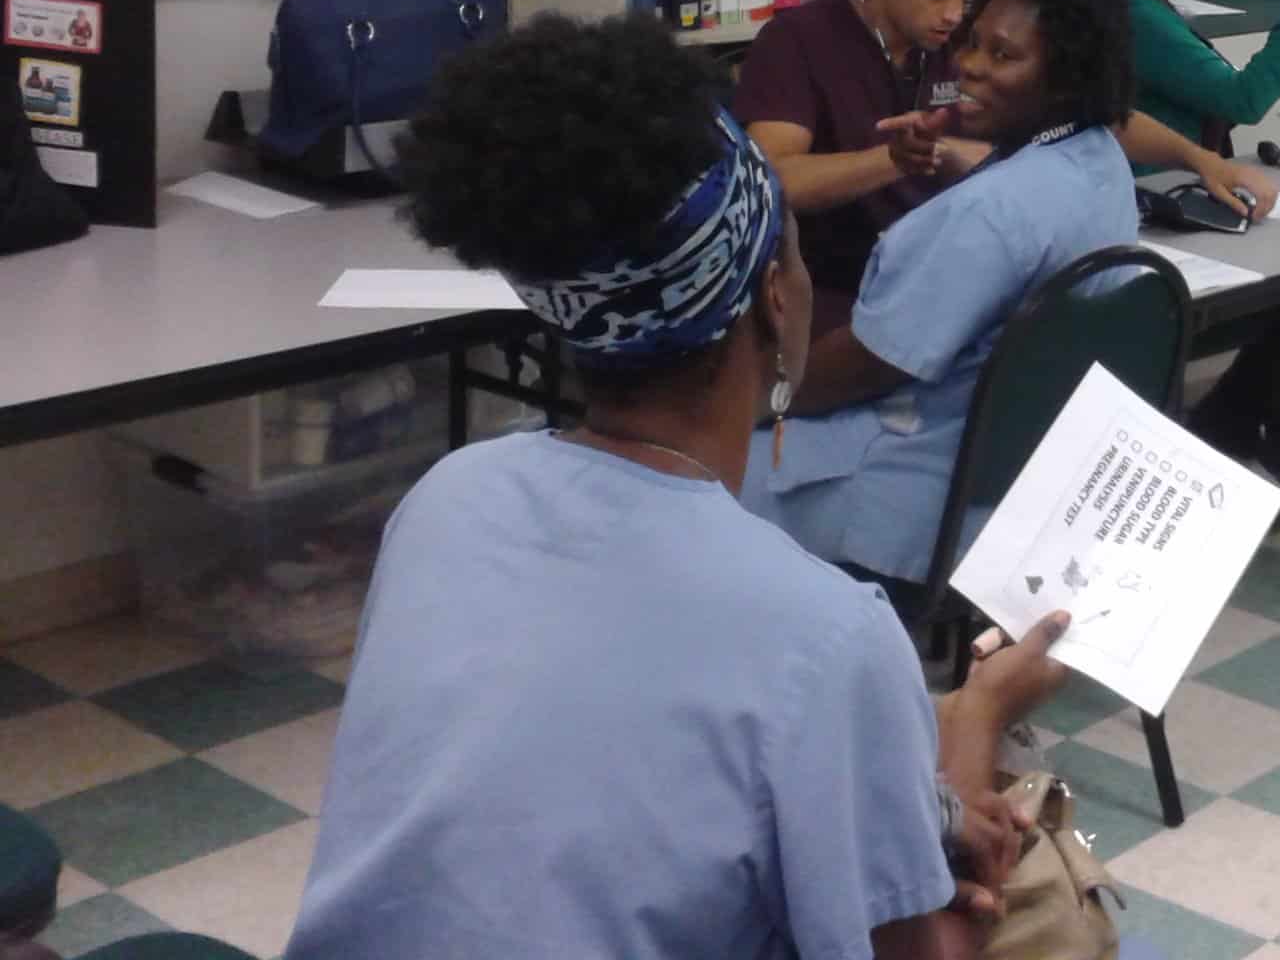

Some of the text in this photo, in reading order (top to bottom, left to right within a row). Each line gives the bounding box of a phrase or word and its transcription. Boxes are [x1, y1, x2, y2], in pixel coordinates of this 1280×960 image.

[1063, 444, 1119, 527] PREGNANCY TEST
[1093, 455, 1134, 511] URINALYSIS
[1094, 467, 1147, 542] VENIPUNCTURE
[1113, 475, 1162, 545] BLOOD SUGAR
[1136, 485, 1178, 544] BLOOD TYPE
[1152, 496, 1193, 551] VITAL SIGNS
